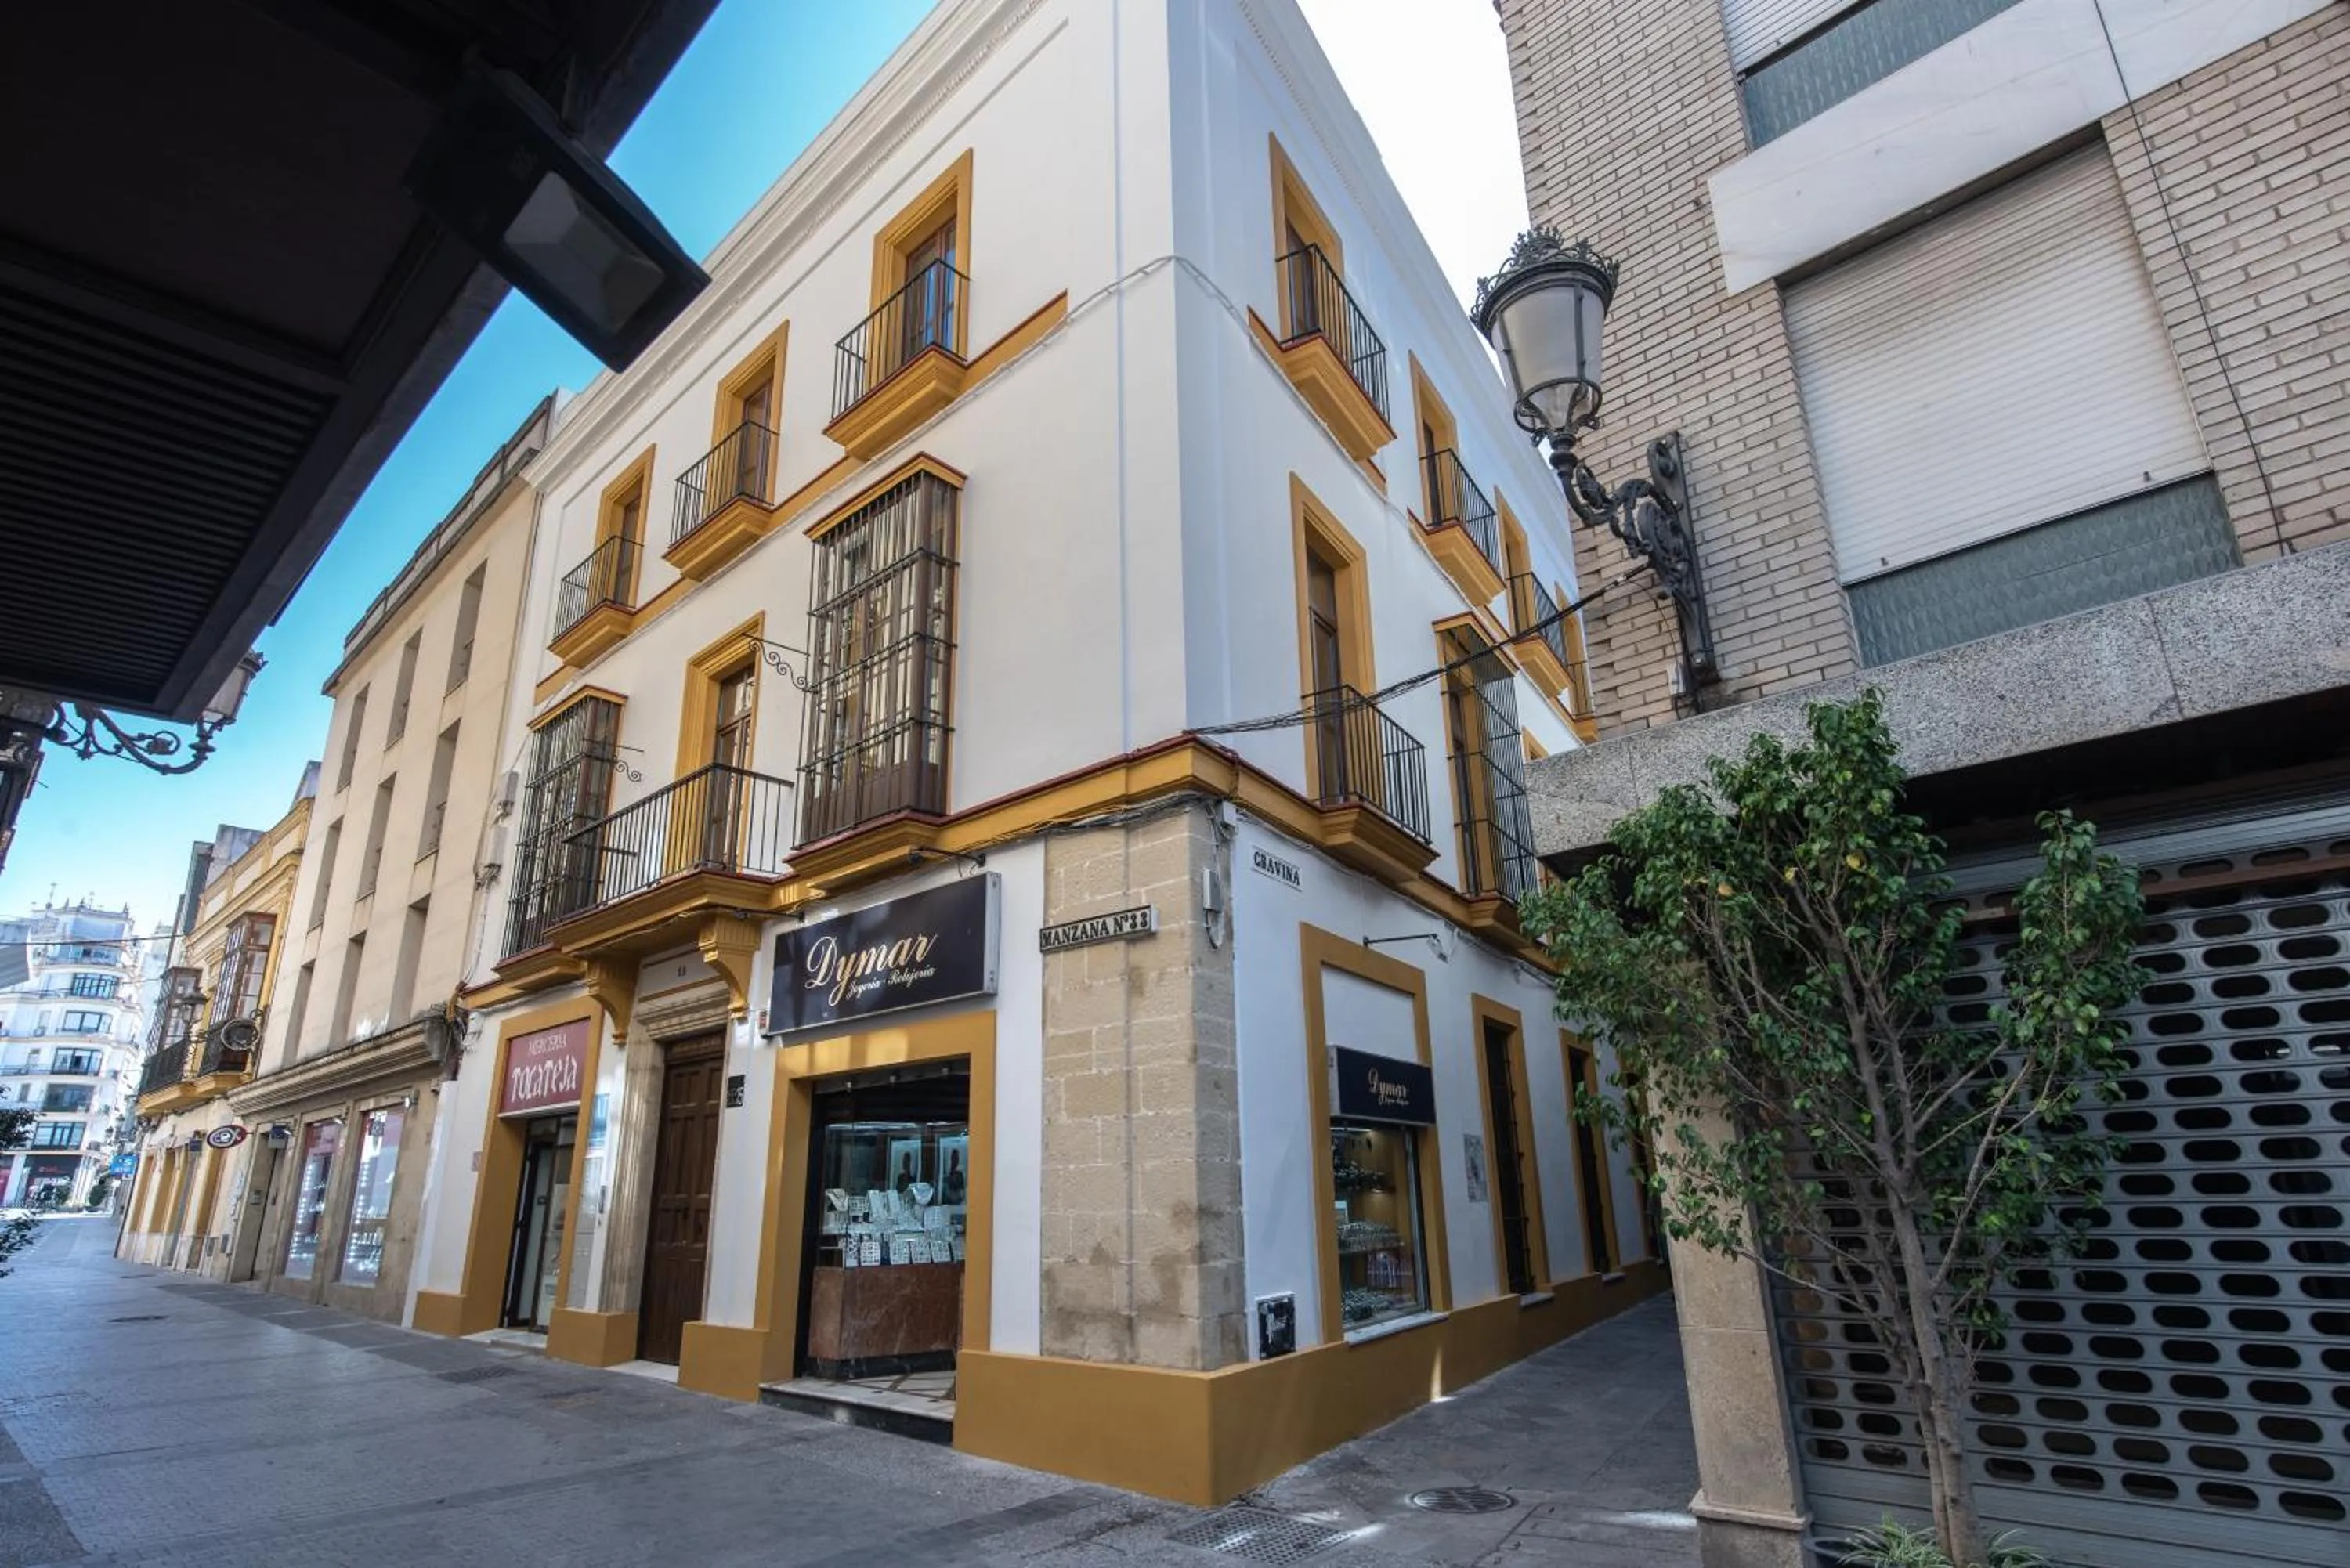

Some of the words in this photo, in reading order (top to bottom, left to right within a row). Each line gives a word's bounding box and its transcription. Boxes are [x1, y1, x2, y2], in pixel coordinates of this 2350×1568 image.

[1254, 851, 1300, 887] GRAVINA
[1043, 919, 1110, 948] MANZANA
[804, 934, 938, 1006] Dymar
[1368, 1066, 1408, 1106] Dymar
